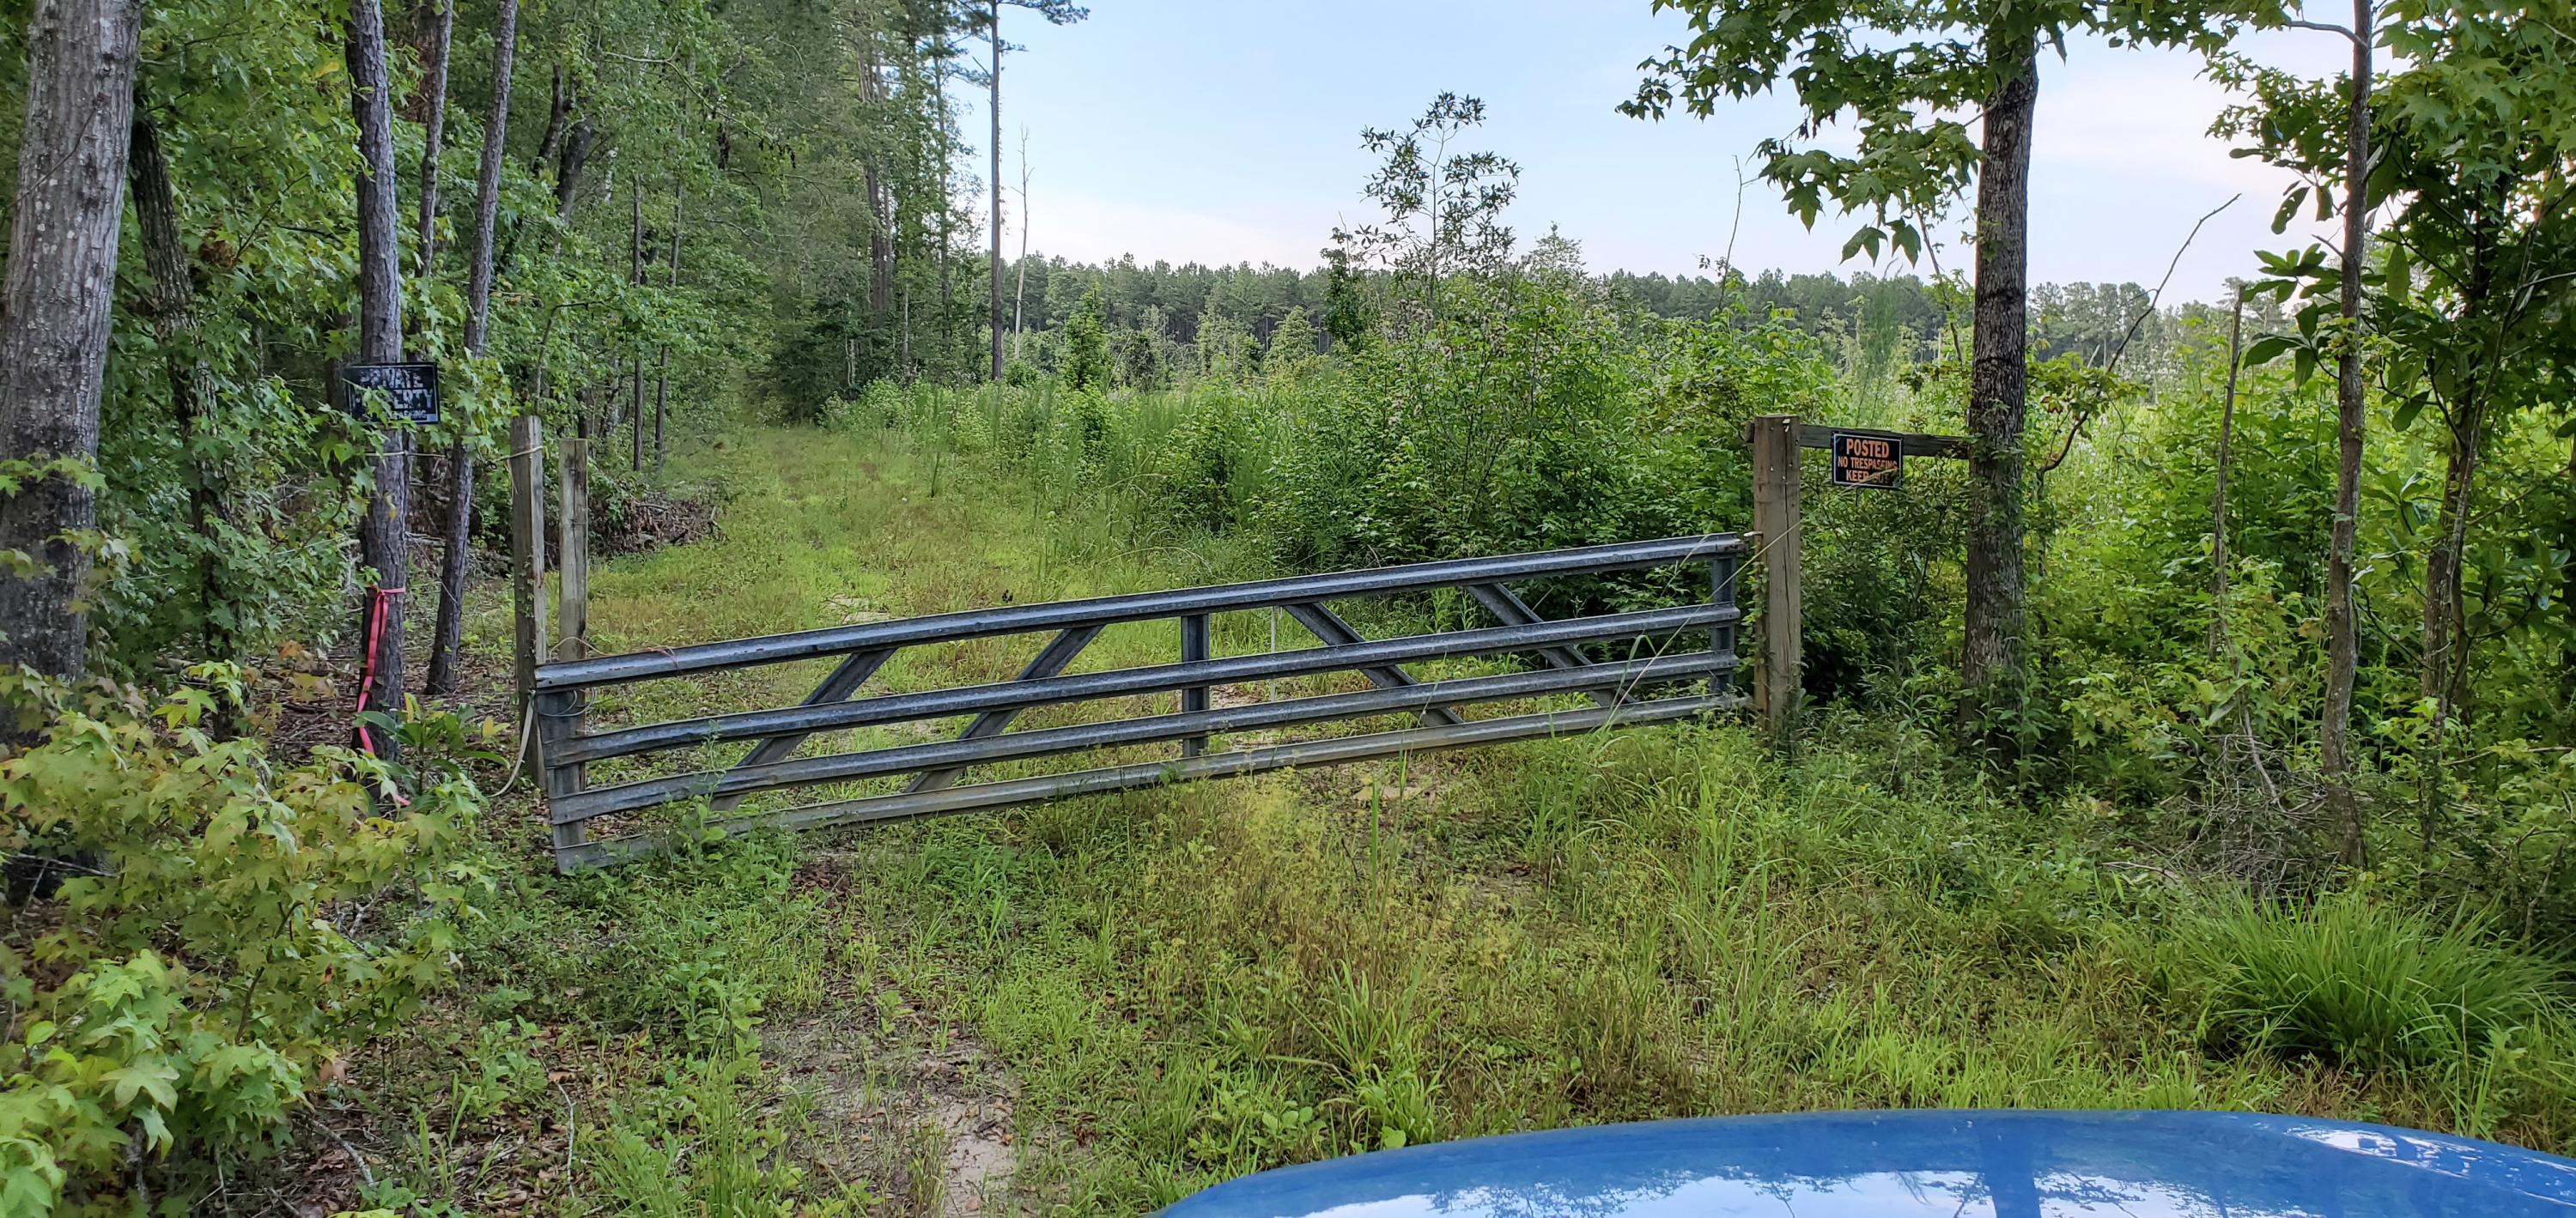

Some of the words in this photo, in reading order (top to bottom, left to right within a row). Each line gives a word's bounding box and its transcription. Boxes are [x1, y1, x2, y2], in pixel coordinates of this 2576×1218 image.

[1846, 438, 1889, 458] POSTED
[1838, 456, 1848, 468] NO
[1846, 470, 1868, 481] KEEP
